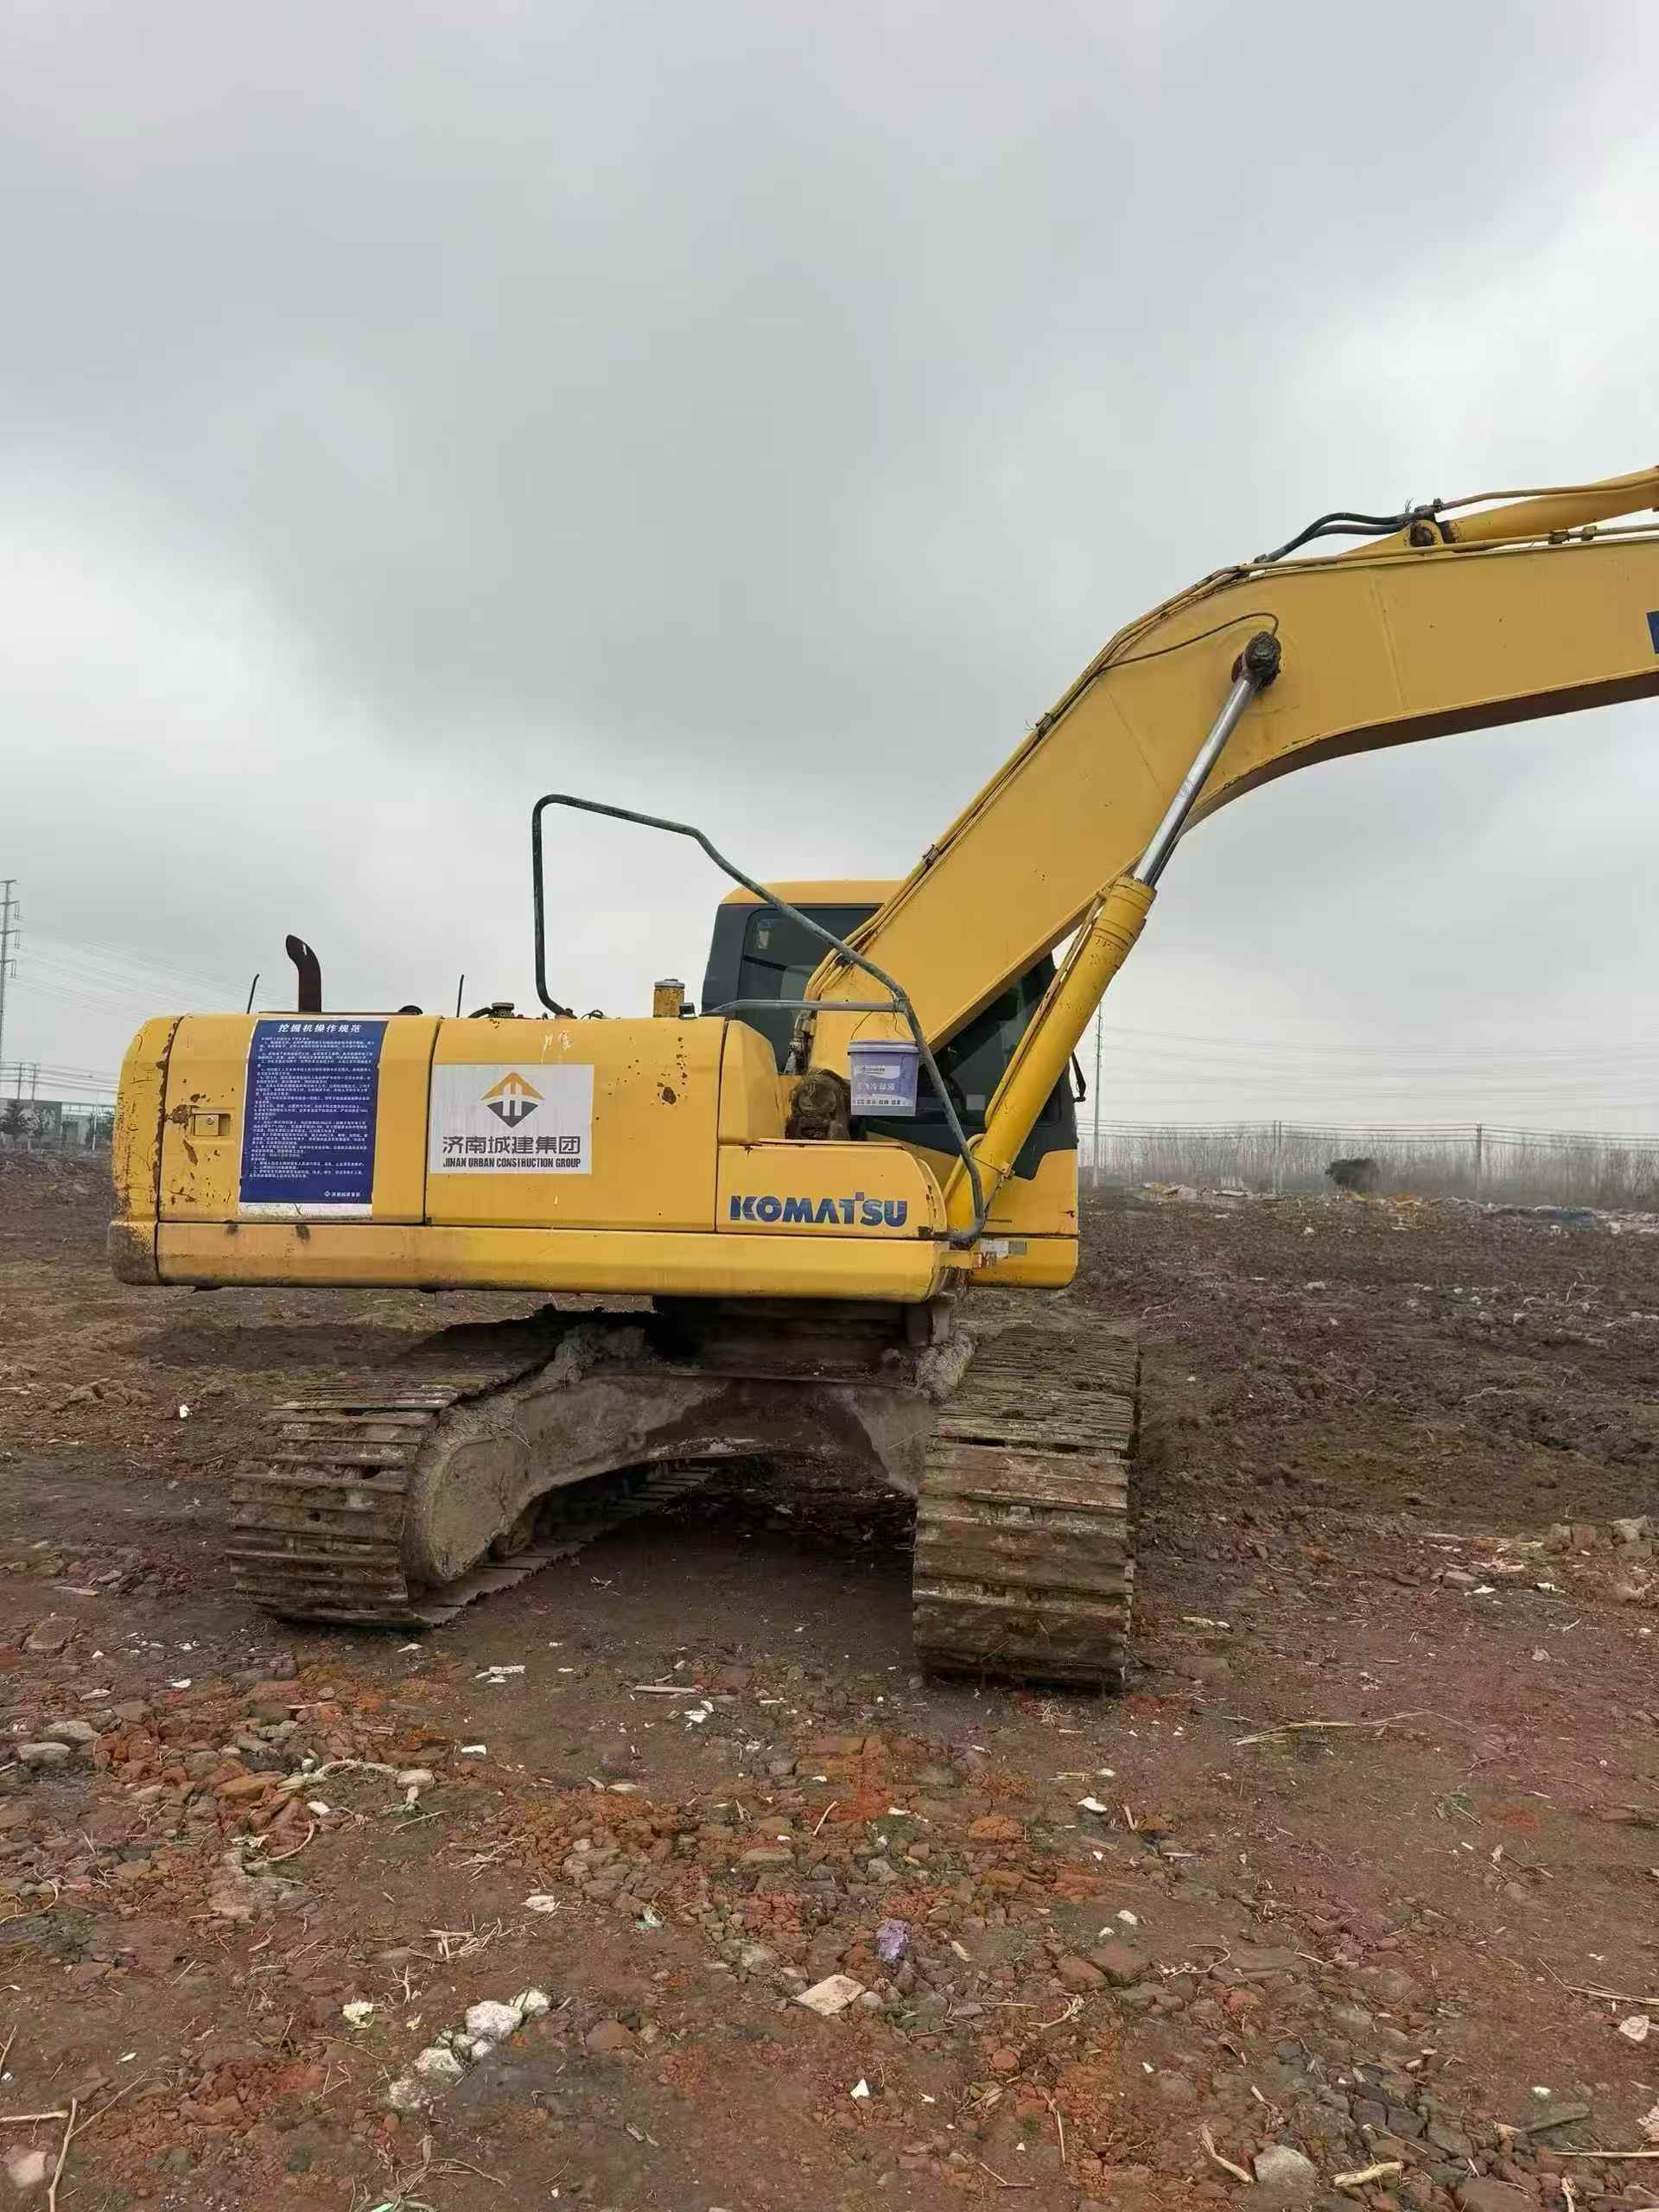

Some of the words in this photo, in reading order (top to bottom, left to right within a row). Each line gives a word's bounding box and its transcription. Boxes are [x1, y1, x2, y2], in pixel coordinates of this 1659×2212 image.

[277, 1022, 362, 1033] 挖掘机操作规范
[442, 1135, 582, 1154] 济南城建集团
[442, 1157, 467, 1168] JINAN
[468, 1157, 495, 1168] URBAN
[496, 1157, 554, 1168] CONSTRUCTION
[556, 1157, 582, 1168] GROUP
[729, 1192, 908, 1228] KOMATSU
